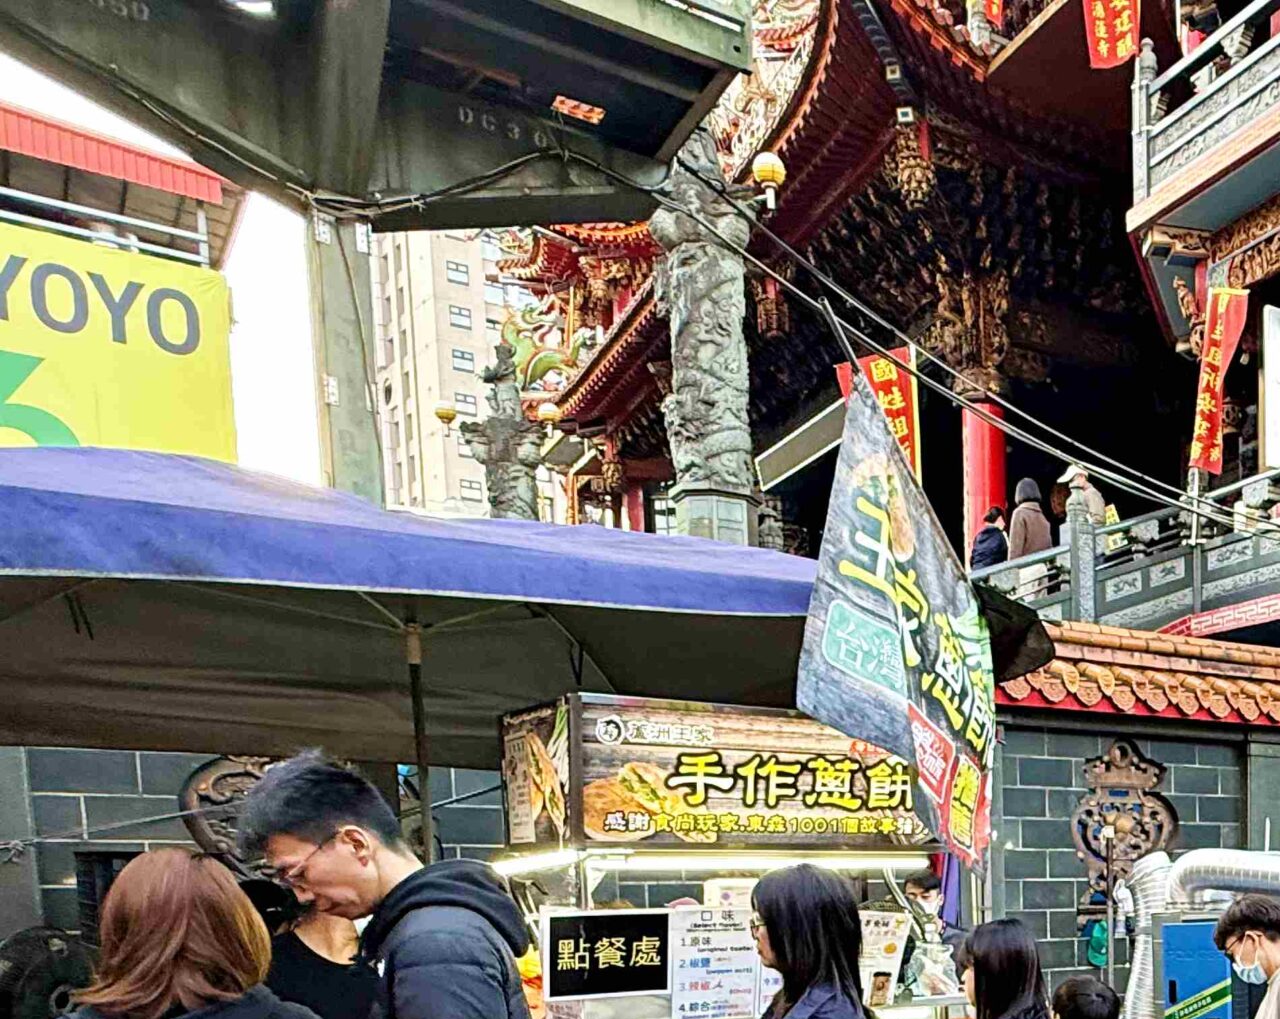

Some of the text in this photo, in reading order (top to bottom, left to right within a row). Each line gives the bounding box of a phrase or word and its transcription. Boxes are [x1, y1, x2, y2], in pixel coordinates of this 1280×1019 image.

[0, 254, 200, 356] YOYO
[557, 935, 661, 971] 點餐處
